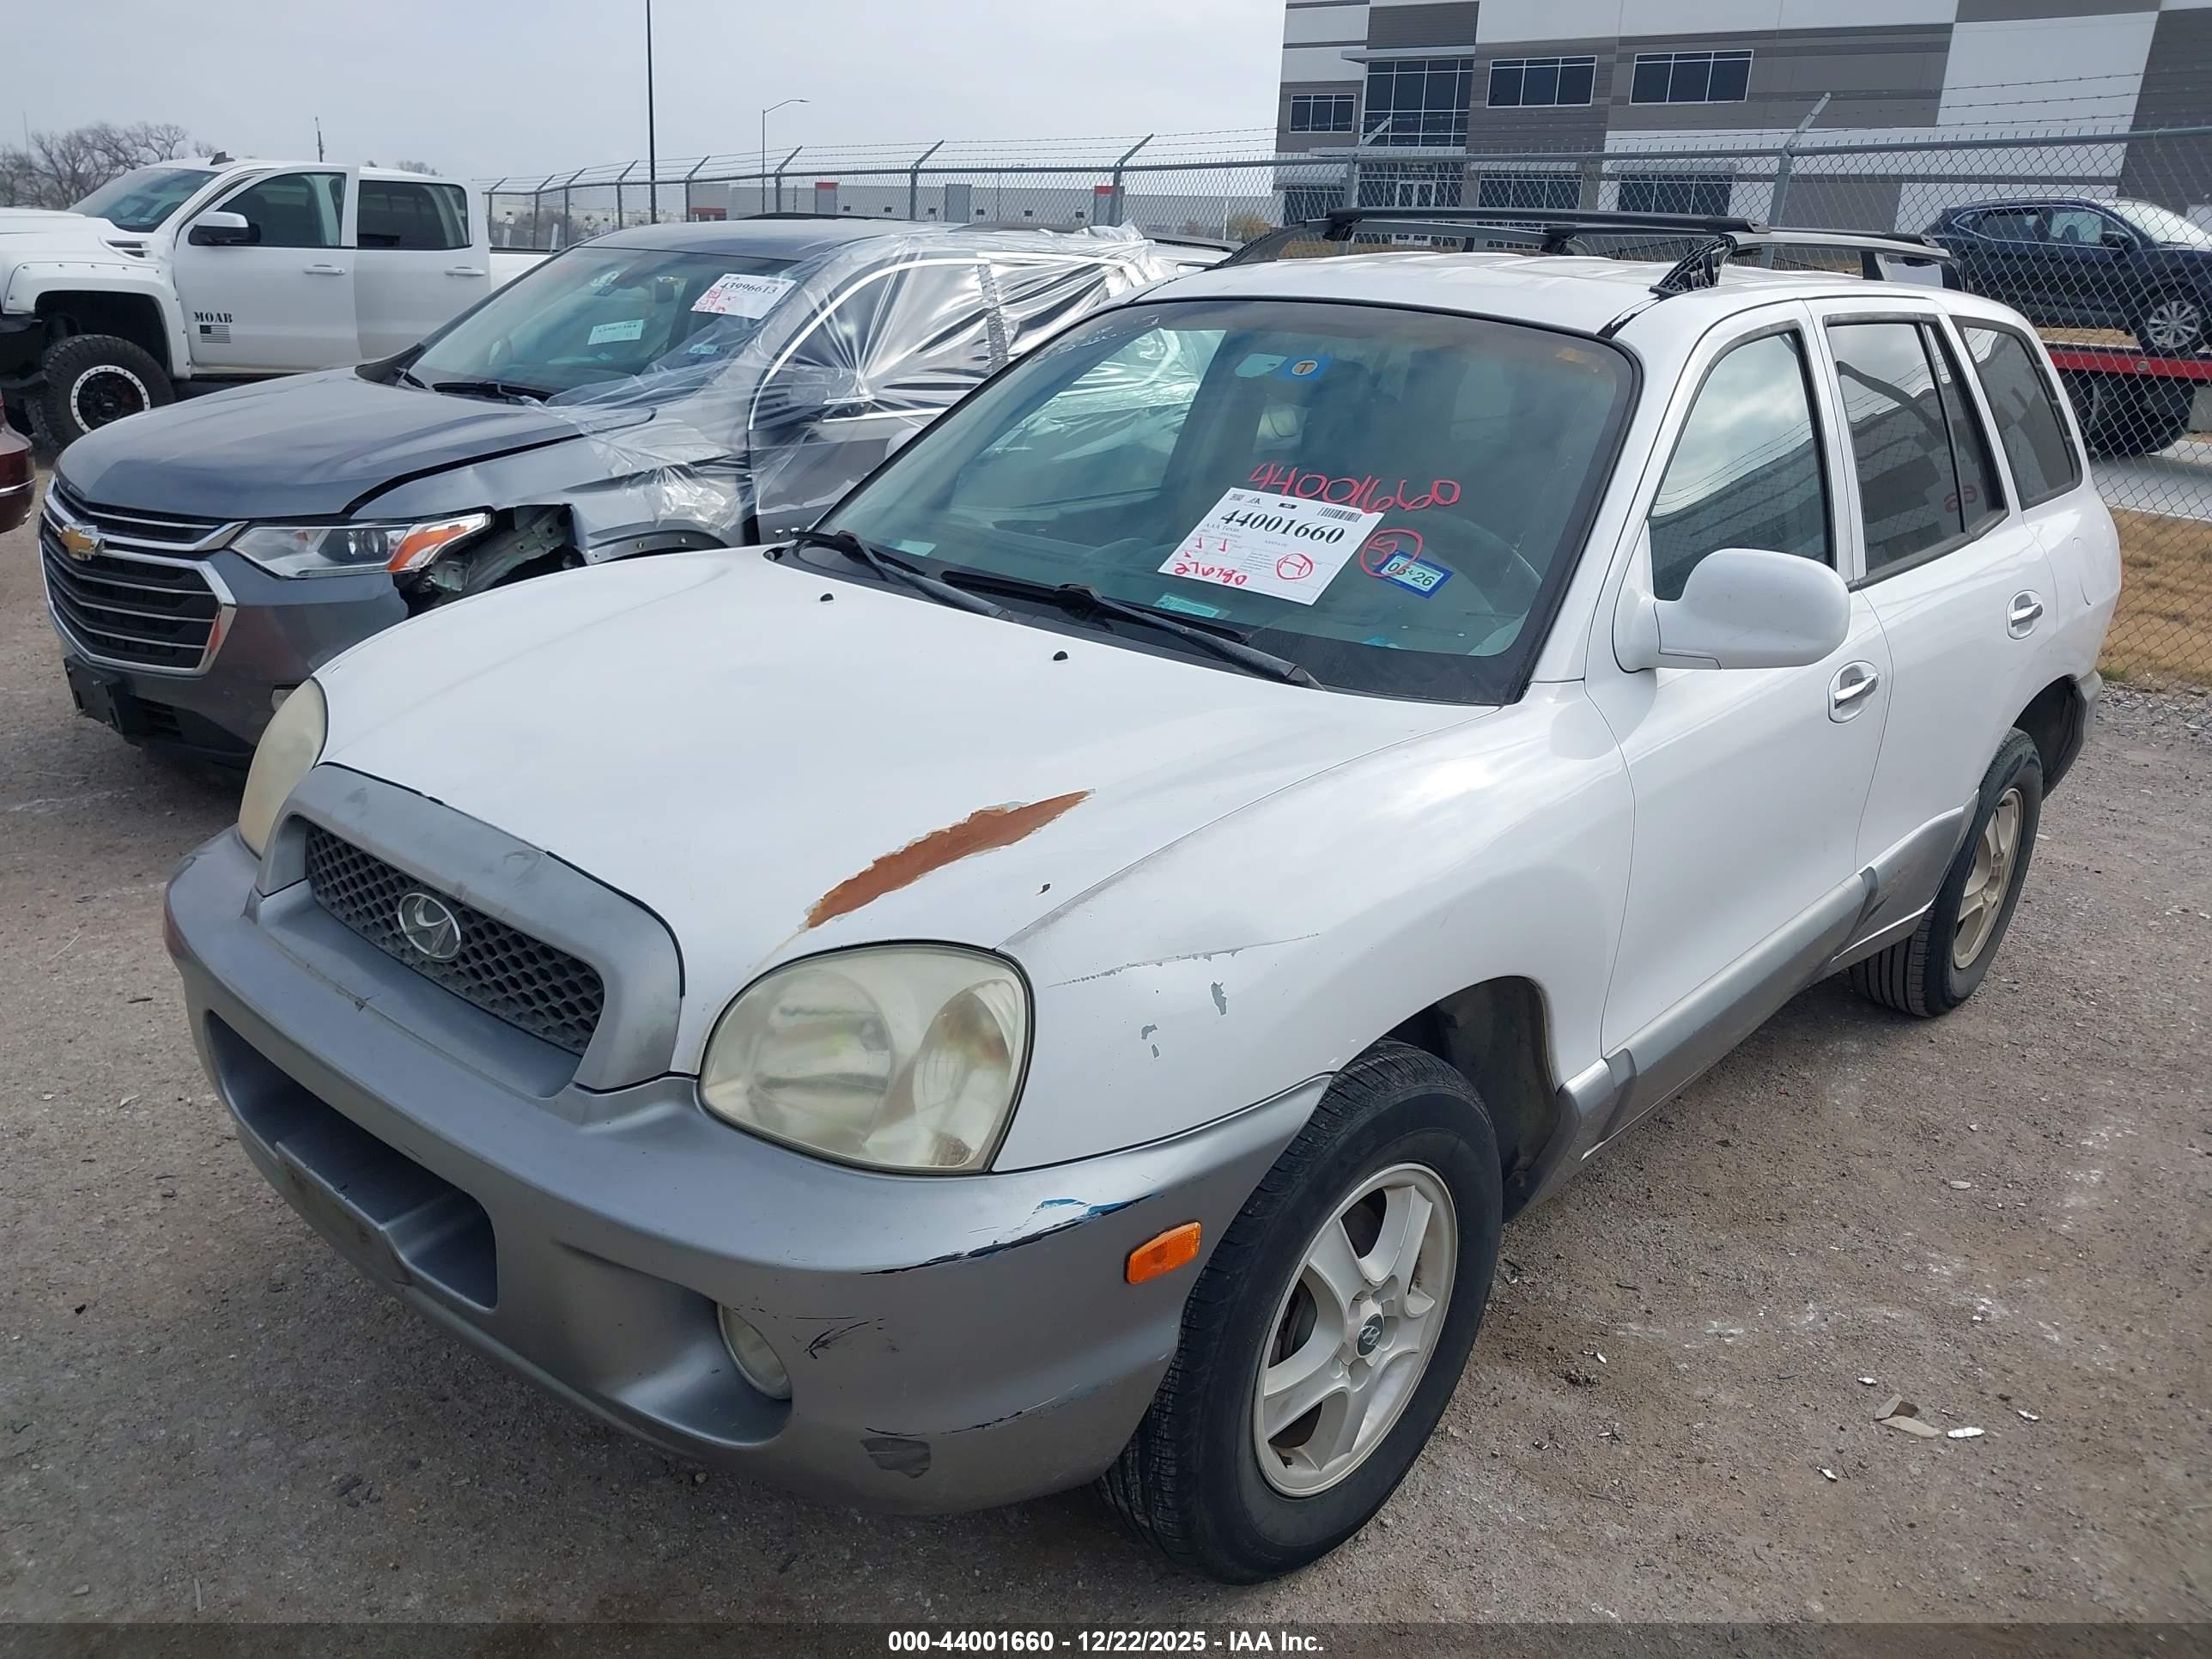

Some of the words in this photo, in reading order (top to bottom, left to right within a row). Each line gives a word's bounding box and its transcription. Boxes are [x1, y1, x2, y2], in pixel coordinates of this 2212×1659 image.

[720, 282, 778, 295] 43996613
[193, 311, 233, 323] MOAB
[1249, 462, 1460, 514] 44001660
[1220, 509, 1346, 544] 44001660
[1411, 571, 1436, 586] 26
